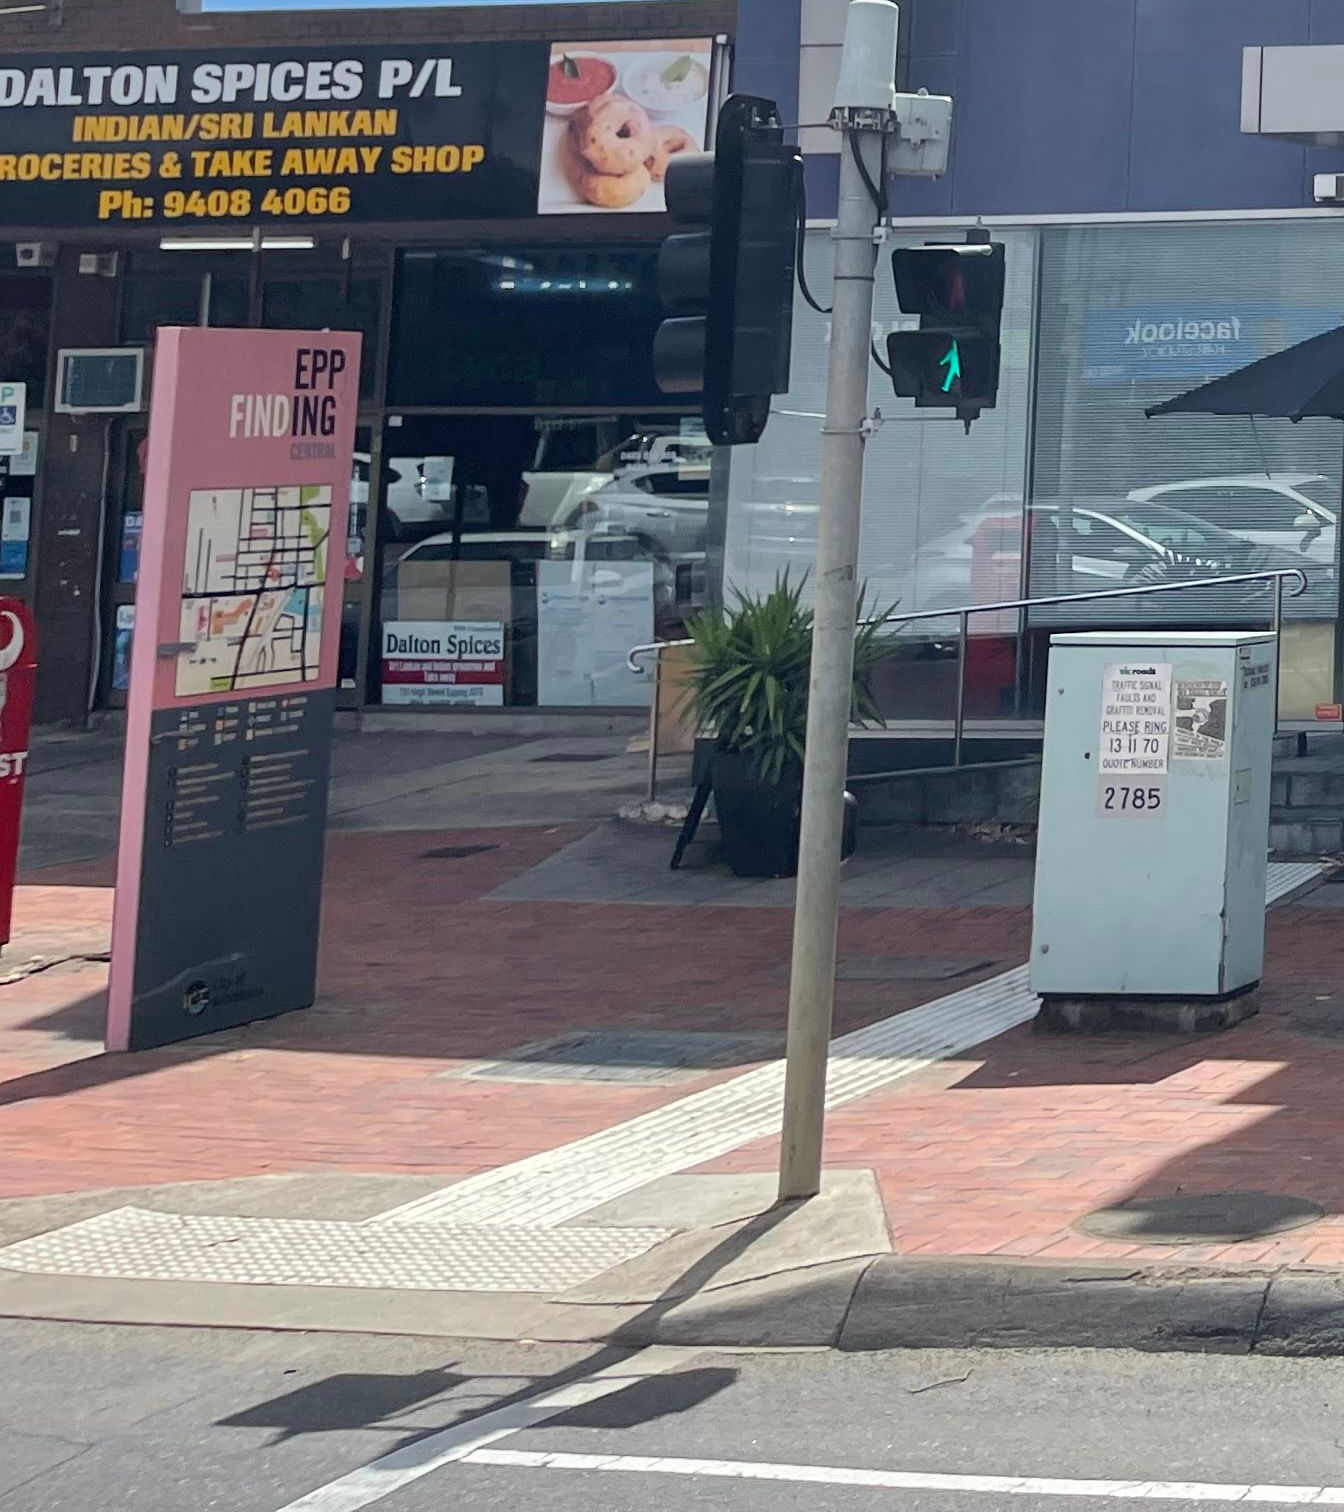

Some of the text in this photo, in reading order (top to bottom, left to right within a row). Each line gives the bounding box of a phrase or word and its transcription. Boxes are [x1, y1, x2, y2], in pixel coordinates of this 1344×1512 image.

[0, 58, 462, 107] DALTON SPICES P/L
[72, 109, 398, 143] INDIAN/SRI LANKAN
[159, 151, 182, 179] &
[191, 149, 273, 178] TAKE
[280, 146, 383, 176] AWAY
[390, 145, 485, 174] SHOP
[98, 186, 351, 219] Ph: 9408 4066
[295, 349, 346, 390] EPP
[386, 634, 501, 660] Dalton Spices
[1112, 680, 1162, 690] TRAFFIC SIGNAL
[1116, 693, 1156, 703] FAULTS AND
[1136, 705, 1166, 716] REMOVAL
[1103, 721, 1167, 734] PLEASE RING
[1109, 738, 1121, 754] 13
[1144, 738, 1159, 754] 70
[1103, 758, 1164, 769] QUOTE NUMBER
[1105, 787, 1161, 810] 2785
